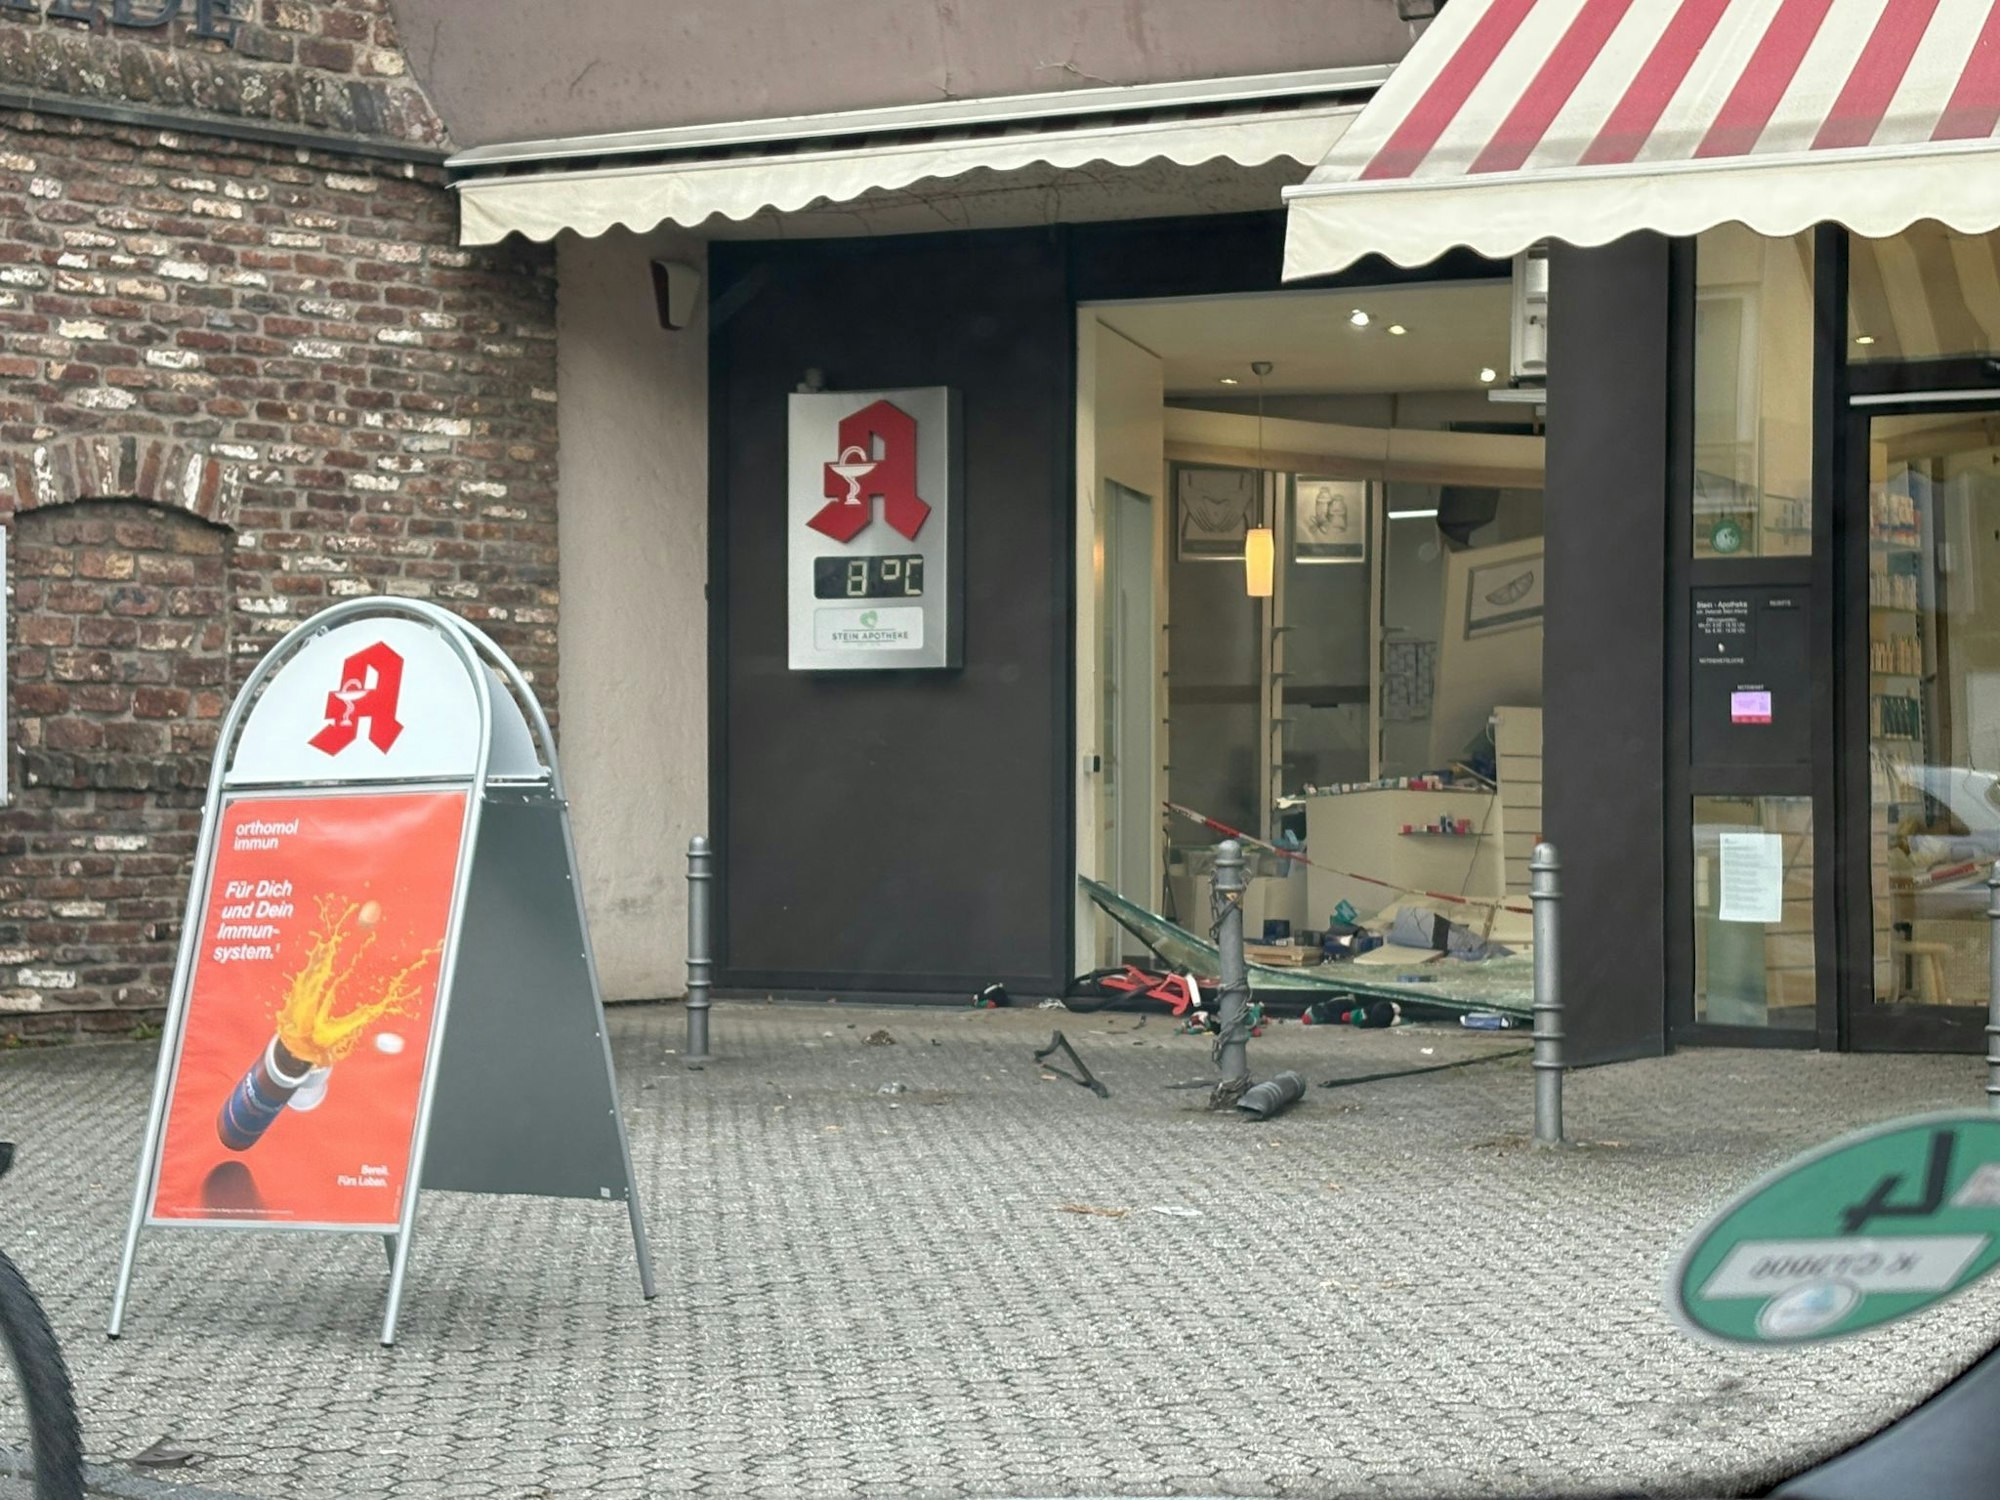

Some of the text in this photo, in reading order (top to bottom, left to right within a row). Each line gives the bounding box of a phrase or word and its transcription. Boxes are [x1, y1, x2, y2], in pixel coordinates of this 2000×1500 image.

[832, 630, 909, 641] STEIN APOTHEKE
[235, 818, 299, 836] orthomol
[234, 836, 279, 851] immun
[225, 879, 293, 899] Für Dich
[221, 900, 294, 920] und Dein
[216, 922, 280, 940] Immun-
